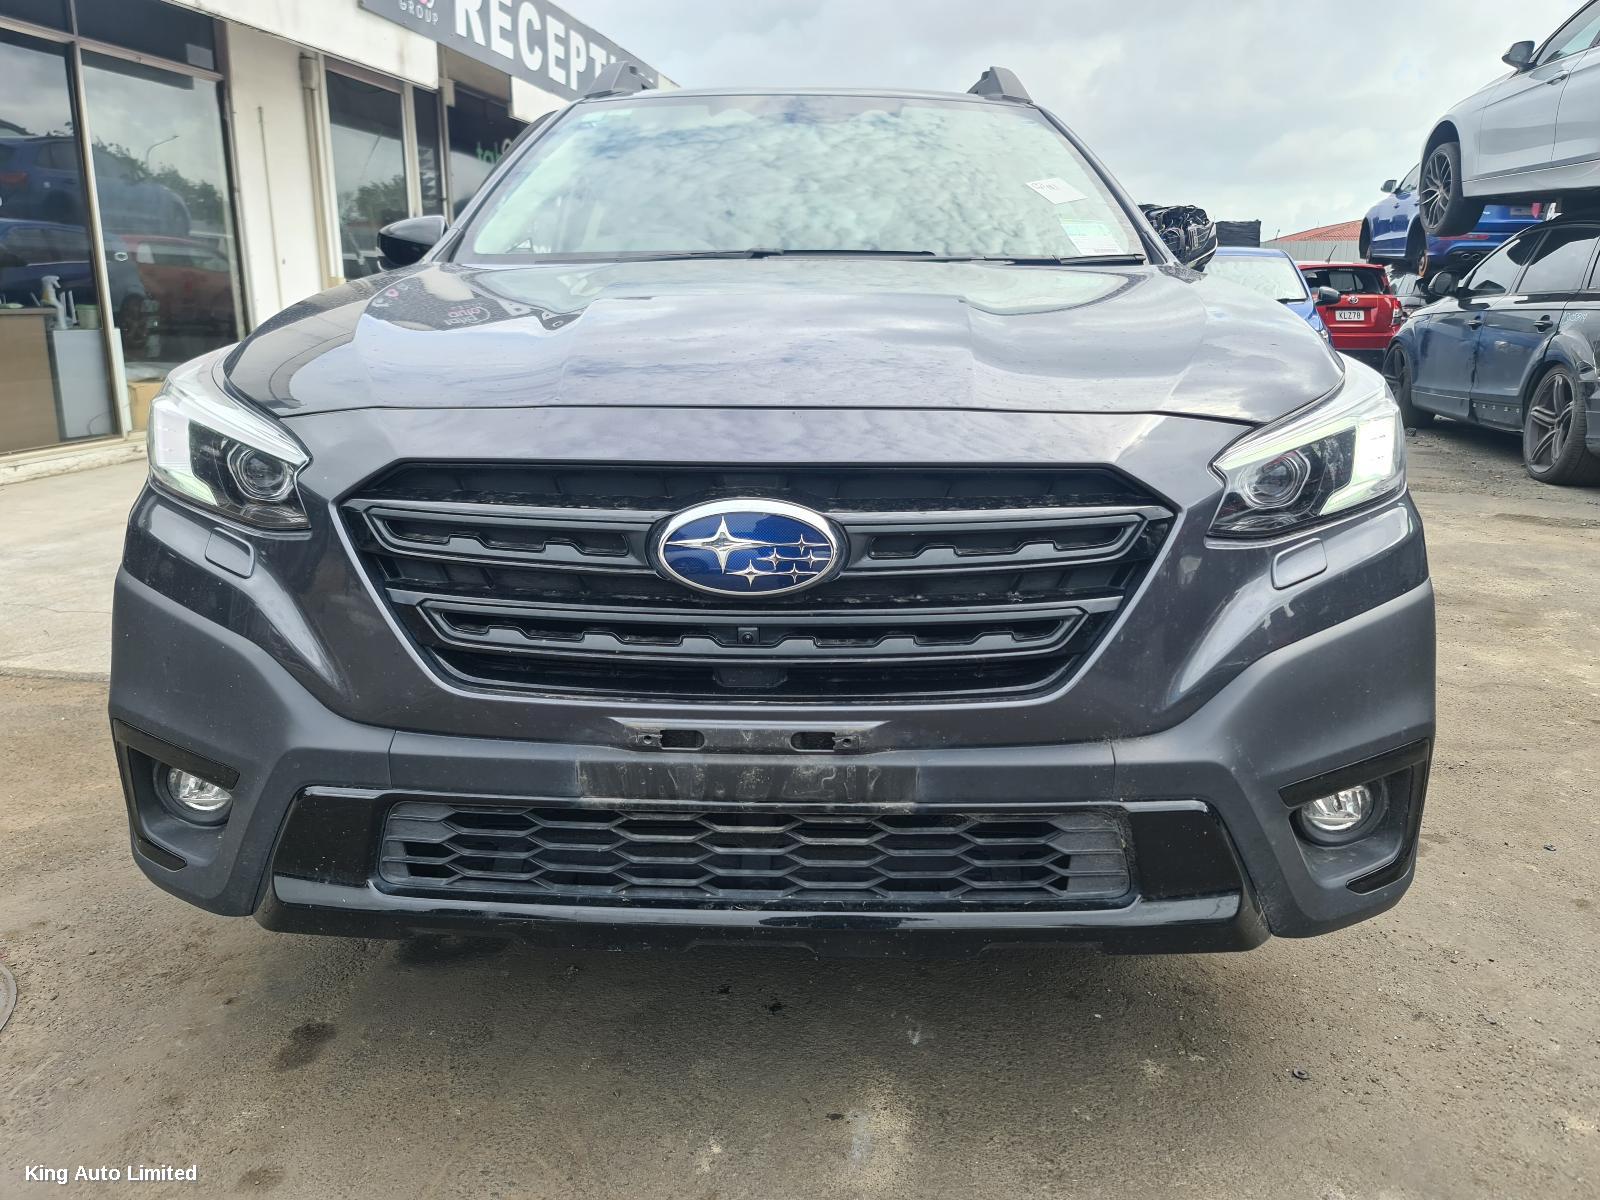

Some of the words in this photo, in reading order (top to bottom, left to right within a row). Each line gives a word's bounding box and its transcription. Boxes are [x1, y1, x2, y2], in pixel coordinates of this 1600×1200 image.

[399, 0, 439, 25] GROUP
[454, 0, 654, 90] RECEPT
[1338, 311, 1361, 320] KLZ78
